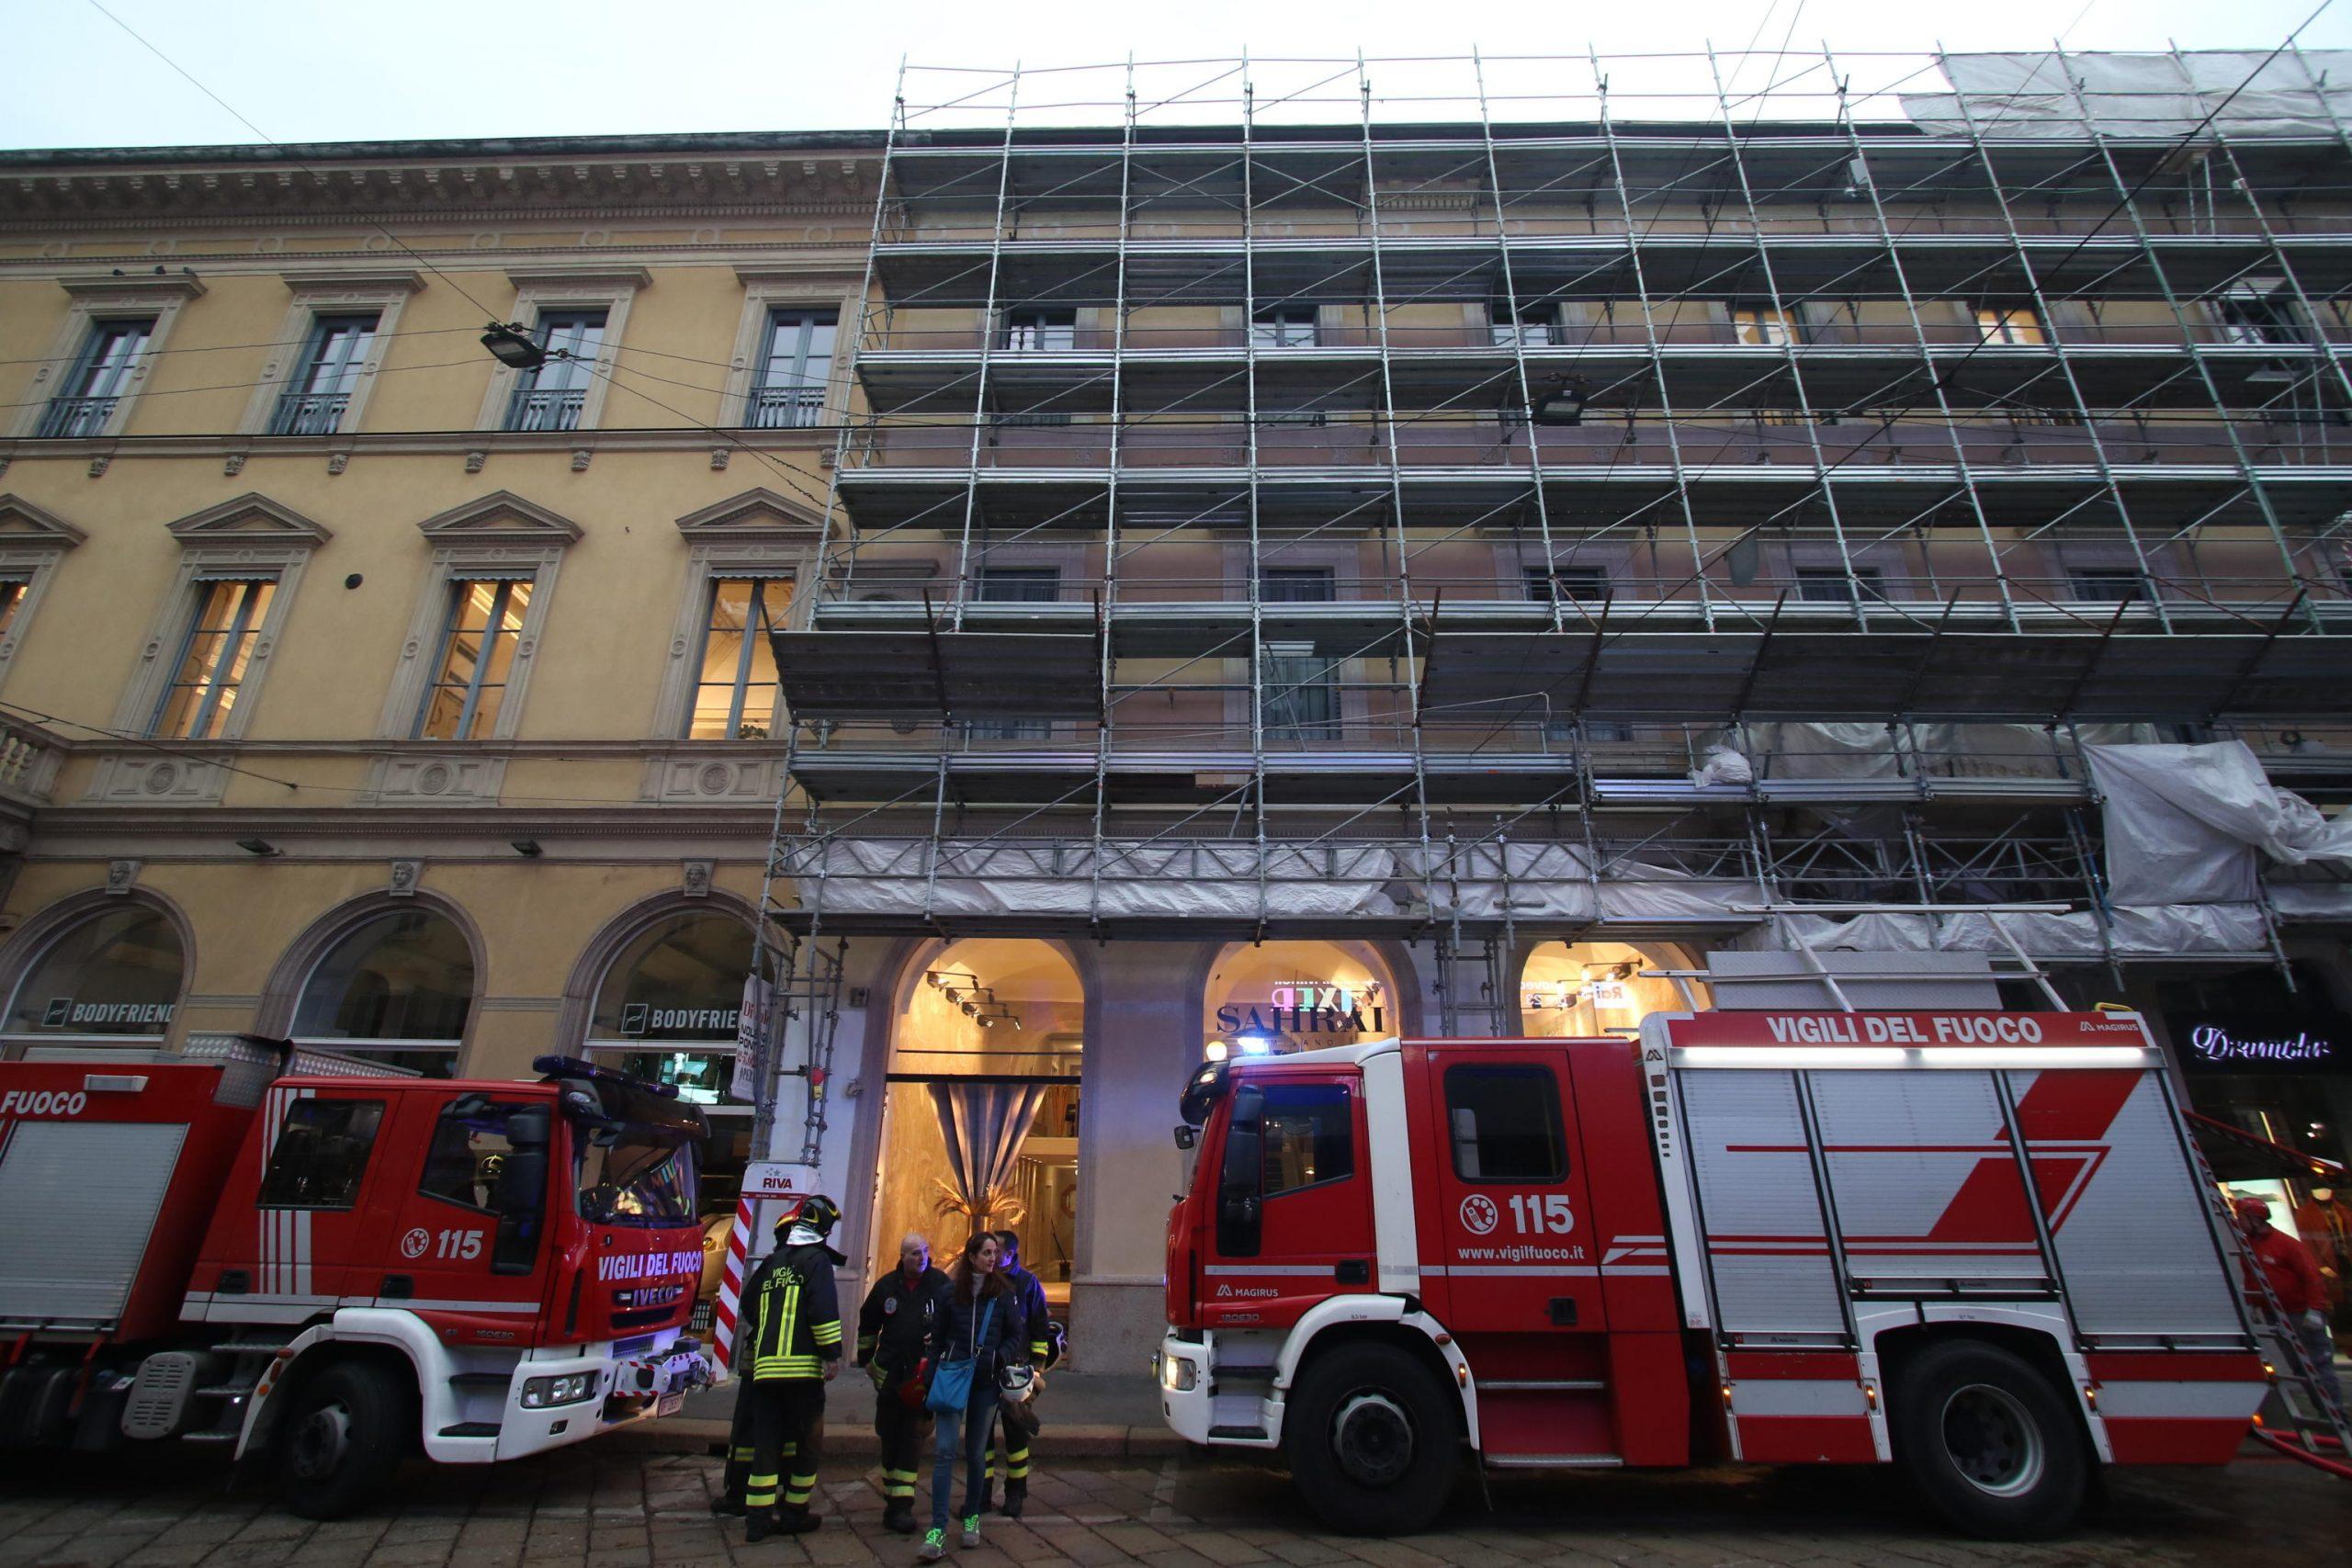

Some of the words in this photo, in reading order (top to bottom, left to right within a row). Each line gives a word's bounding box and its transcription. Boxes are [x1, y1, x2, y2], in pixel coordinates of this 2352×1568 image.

[651, 1010, 739, 1029] BODYFRIE
[1217, 1006, 1386, 1033] SAHRAI
[1767, 1017, 1860, 1043] VIGILI
[1862, 1017, 1929, 1043] DEL
[1932, 1017, 2042, 1043] FUOCO
[2097, 1023, 2139, 1032] MAGIRUS
[0, 1090, 86, 1115] FUOCO
[763, 1178, 792, 1190] RIVA
[1509, 1194, 1575, 1235] 115
[436, 1229, 484, 1259] 115
[1458, 1246, 1585, 1262] www.vigilfuoco.it
[598, 1255, 644, 1281] VIGILI
[645, 1252, 669, 1278] DEL
[671, 1250, 704, 1276] FUOCO
[632, 1286, 676, 1307] IVECO
[1235, 1288, 1279, 1297] MAGIRUS
